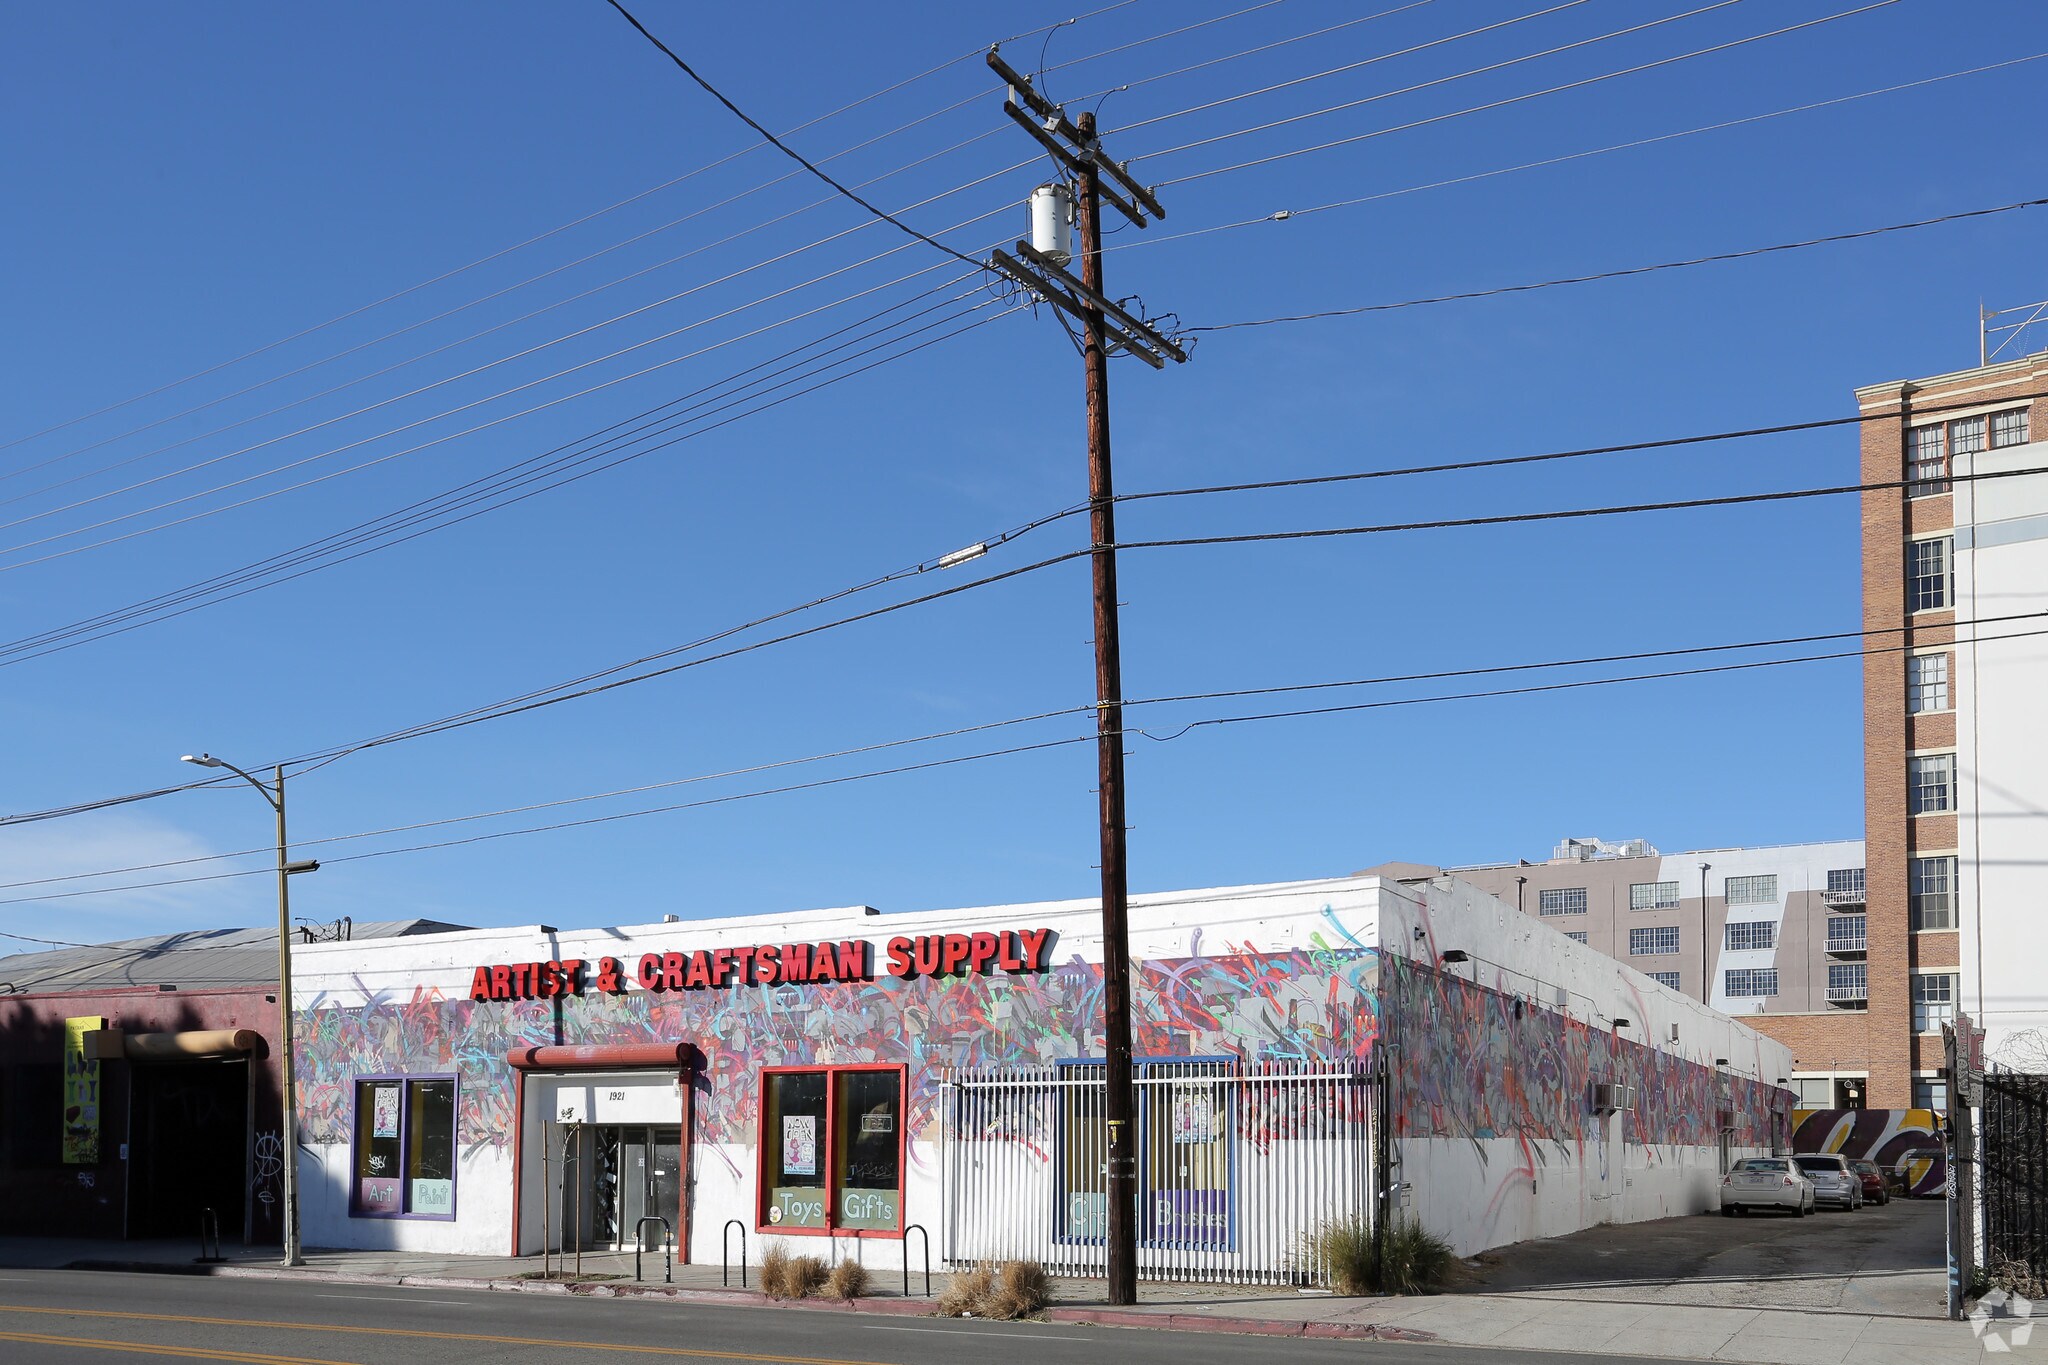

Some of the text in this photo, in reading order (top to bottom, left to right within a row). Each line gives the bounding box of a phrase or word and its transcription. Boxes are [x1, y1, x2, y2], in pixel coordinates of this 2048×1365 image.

[469, 927, 1056, 1001] ARTIST & CRAFTSMAN SUPPLY
[608, 1091, 625, 1101] 1921
[785, 1128, 814, 1142] OPEN
[368, 1184, 394, 1202] Art
[418, 1183, 448, 1205] Paint
[780, 1192, 822, 1225] Toys
[844, 1193, 893, 1220] Gifts
